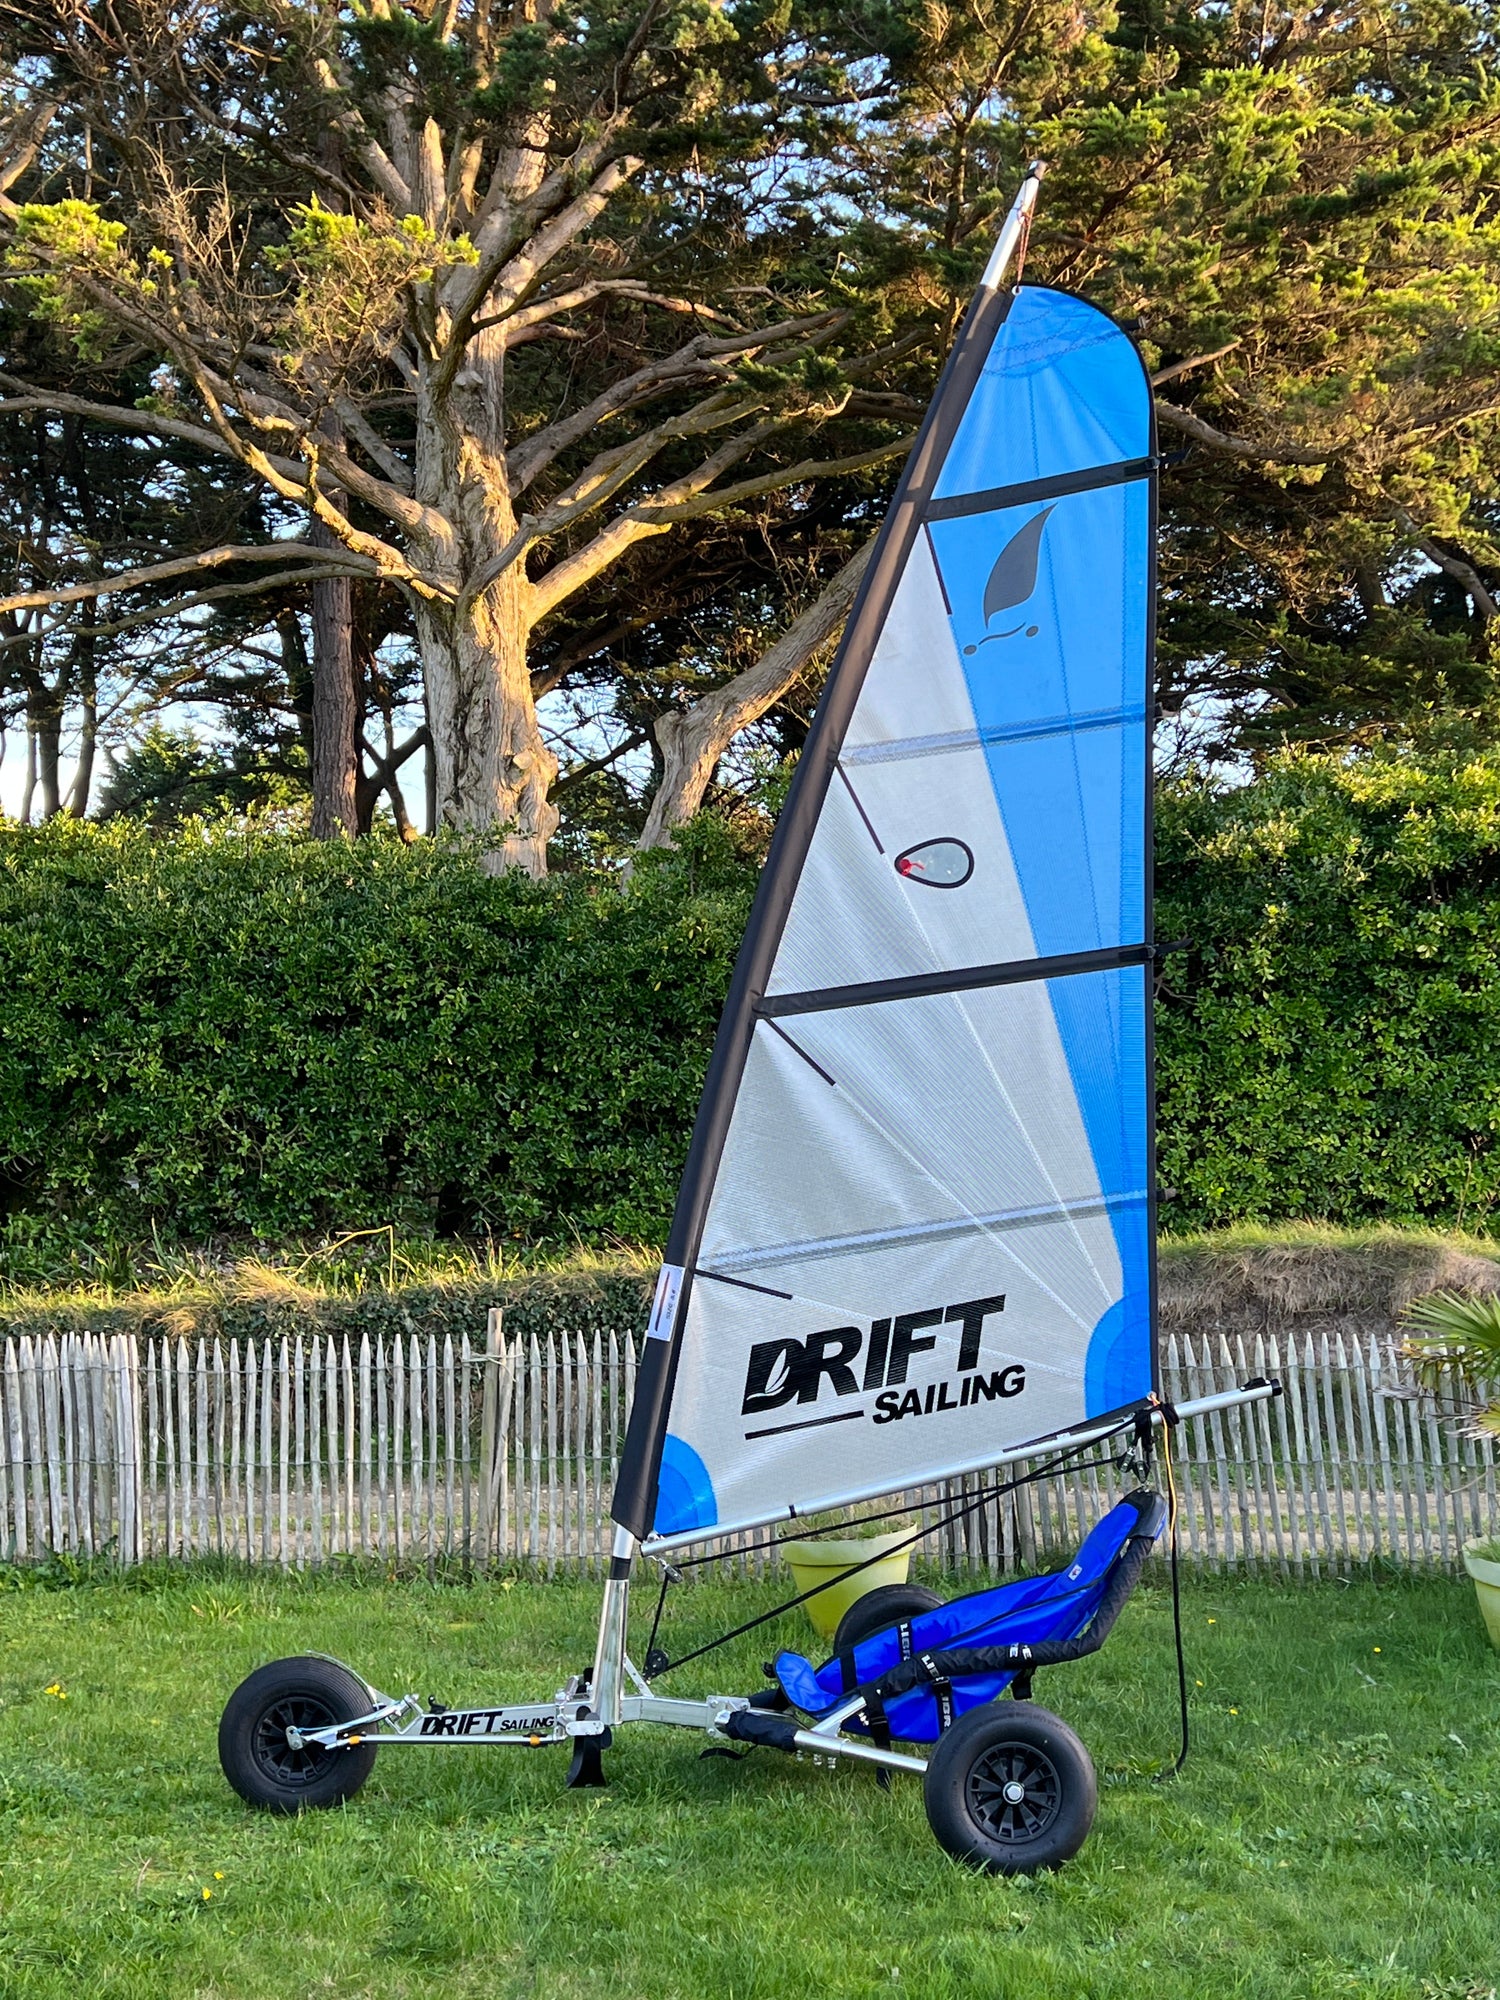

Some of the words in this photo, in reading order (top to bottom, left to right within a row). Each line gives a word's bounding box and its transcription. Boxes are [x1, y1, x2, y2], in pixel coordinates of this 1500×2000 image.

[741, 1294, 1006, 1416] DRIFT
[872, 1364, 1026, 1425] SAILING
[420, 1711, 503, 1736] DRIFT
[500, 1716, 555, 1731] SAILING
